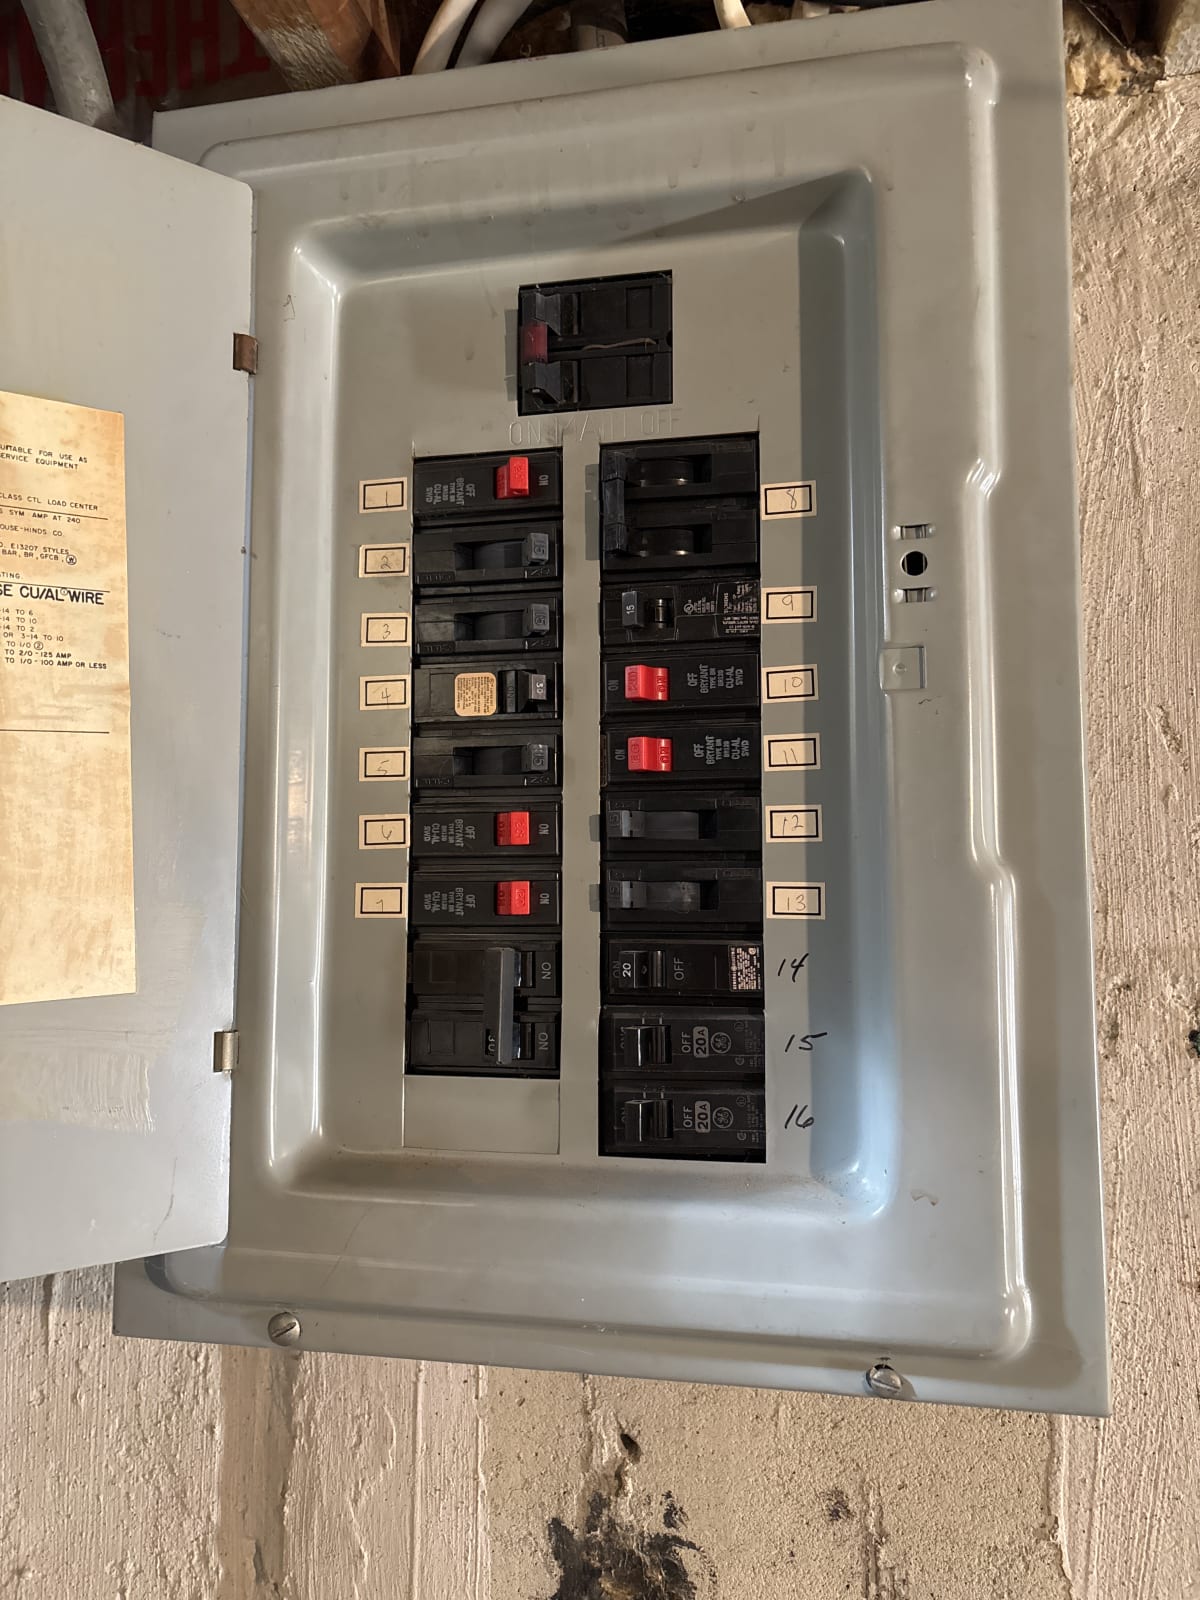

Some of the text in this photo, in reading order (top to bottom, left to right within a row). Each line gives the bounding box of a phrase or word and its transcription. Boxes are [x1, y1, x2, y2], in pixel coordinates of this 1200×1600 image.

[0, 445, 32, 454] UITABLE
[59, 452, 73, 461] USE
[0, 452, 78, 470] ERVICE EQUIPMENT
[538, 474, 549, 486] ON
[456, 478, 464, 506] BRYANT
[466, 483, 476, 498] OFF
[786, 488, 798, 510] 8
[26, 496, 42, 504] CTL
[70, 502, 98, 511] CENTER
[0, 524, 47, 535] OUSE-HINDS
[42, 546, 70, 555] STYLES
[67, 590, 104, 606] WIRE
[782, 594, 794, 611] 9
[626, 604, 635, 615] 15
[382, 623, 392, 640] 3
[608, 680, 618, 691] ON
[688, 672, 698, 686] OFF
[700, 664, 708, 693] BRYANT
[725, 666, 734, 688] CU-AL
[735, 669, 743, 685] SWD
[784, 676, 803, 692] 10
[615, 749, 625, 760] ON
[694, 743, 704, 758] OFF
[706, 736, 715, 764] BRYANT
[731, 738, 740, 759] CU-AL
[741, 740, 749, 757] SWD
[432, 823, 440, 844] CU-AL
[455, 818, 464, 848] BRYANT
[465, 826, 475, 840] OFF
[538, 824, 550, 834] ON
[431, 891, 440, 912] CU-AL
[455, 888, 464, 916] BRYANT
[466, 894, 476, 908] OFF
[538, 893, 550, 904] ON
[786, 894, 806, 912] 13
[541, 962, 551, 979] ON
[623, 962, 631, 978] 20
[674, 957, 684, 980] OFF
[778, 952, 810, 982] 14
[538, 1032, 548, 1050] ON
[682, 1031, 691, 1053] OFF
[784, 1032, 828, 1053] 15
[683, 1106, 692, 1128] OFF
[784, 1104, 815, 1129] 16
